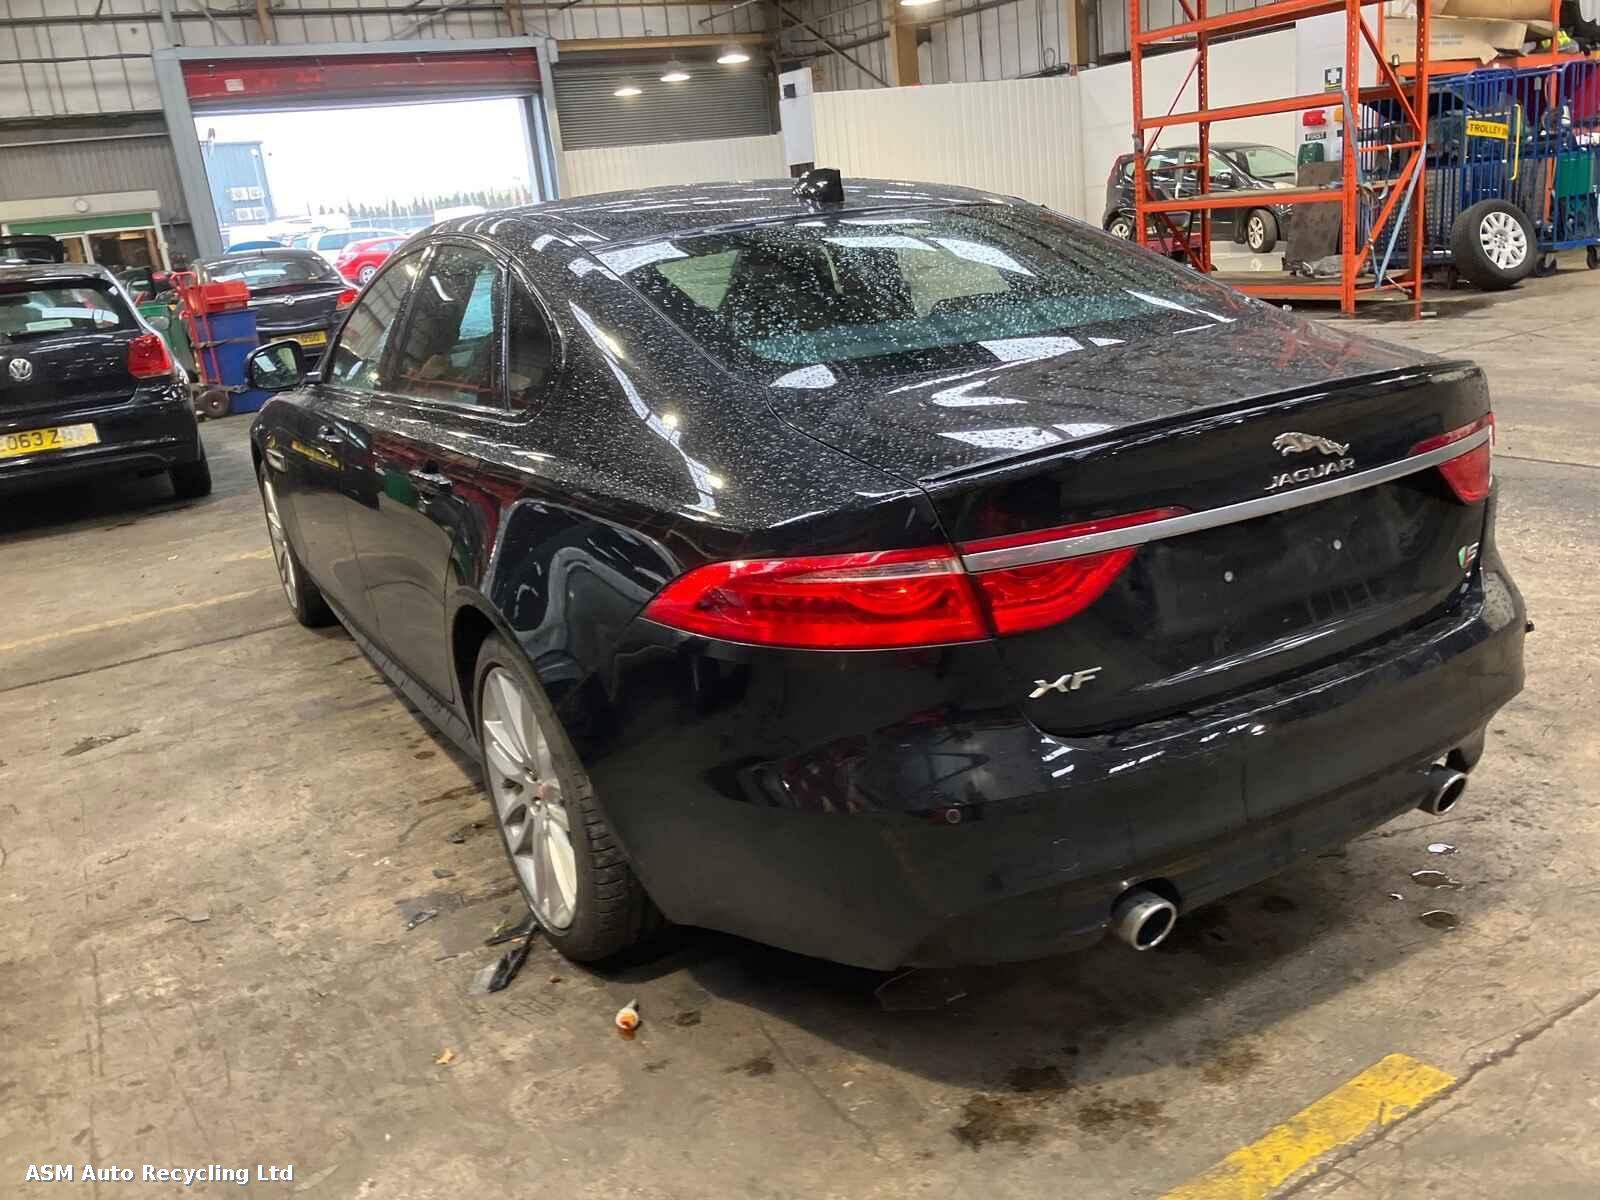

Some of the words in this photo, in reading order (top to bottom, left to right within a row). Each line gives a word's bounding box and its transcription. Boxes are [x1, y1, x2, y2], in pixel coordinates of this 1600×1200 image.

[1469, 123, 1502, 135] TROLLEY
[1264, 457, 1355, 490] JAGUAR
[1028, 666, 1102, 698] XF
